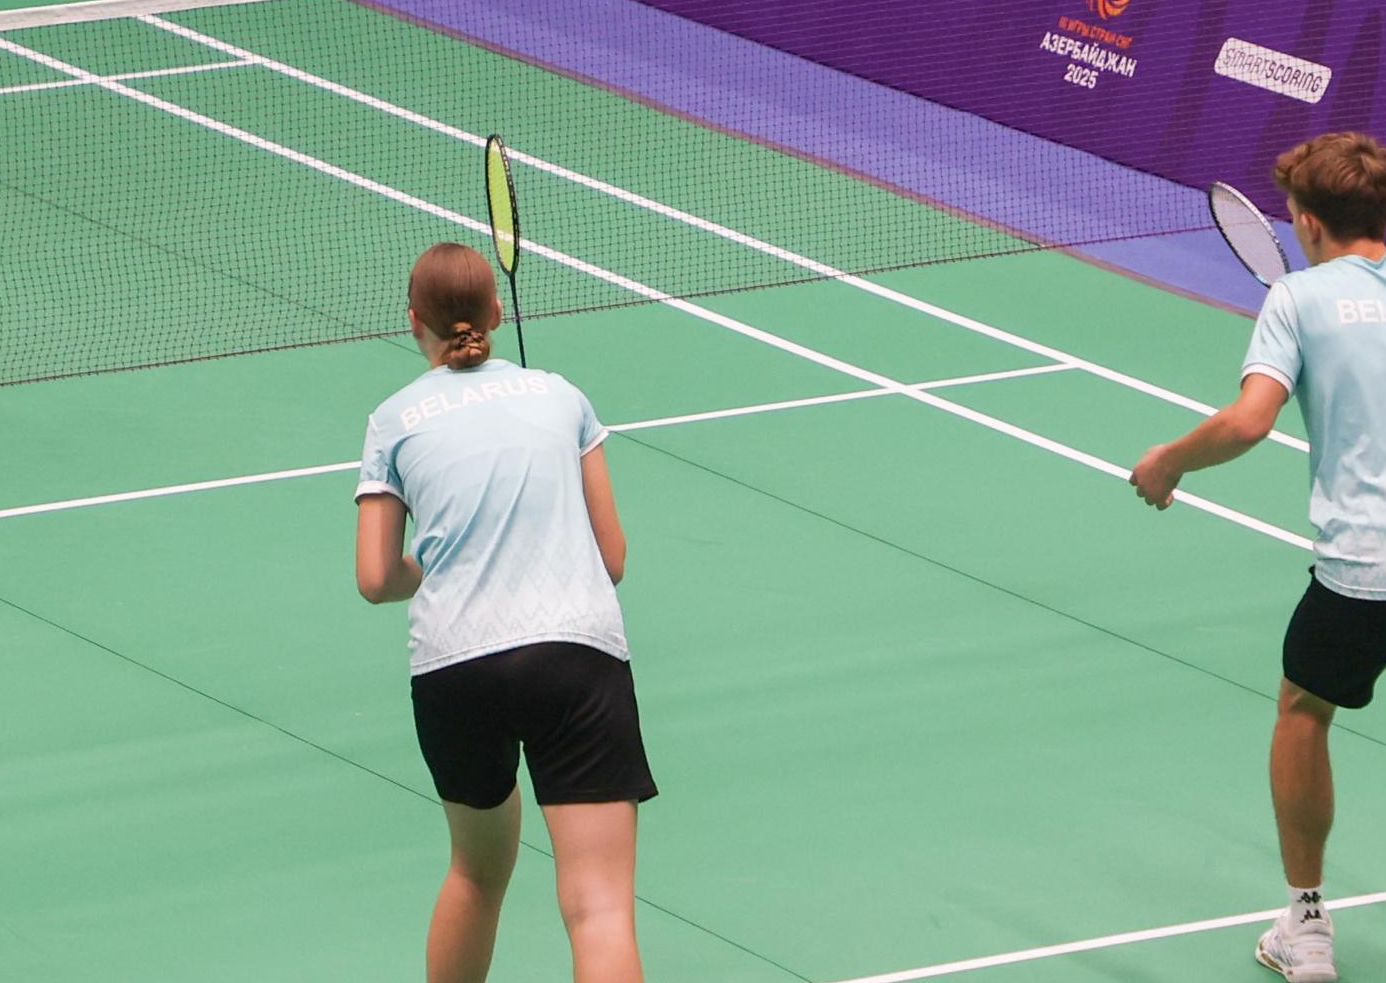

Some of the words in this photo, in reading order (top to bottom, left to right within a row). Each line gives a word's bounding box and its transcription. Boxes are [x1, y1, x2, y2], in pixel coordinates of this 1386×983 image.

[1039, 31, 1138, 78] АЗЕРБАЙДЖАН
[1063, 63, 1099, 89] 2025
[1222, 47, 1323, 94] SMARTSCORING
[399, 374, 551, 432] BELARUS
